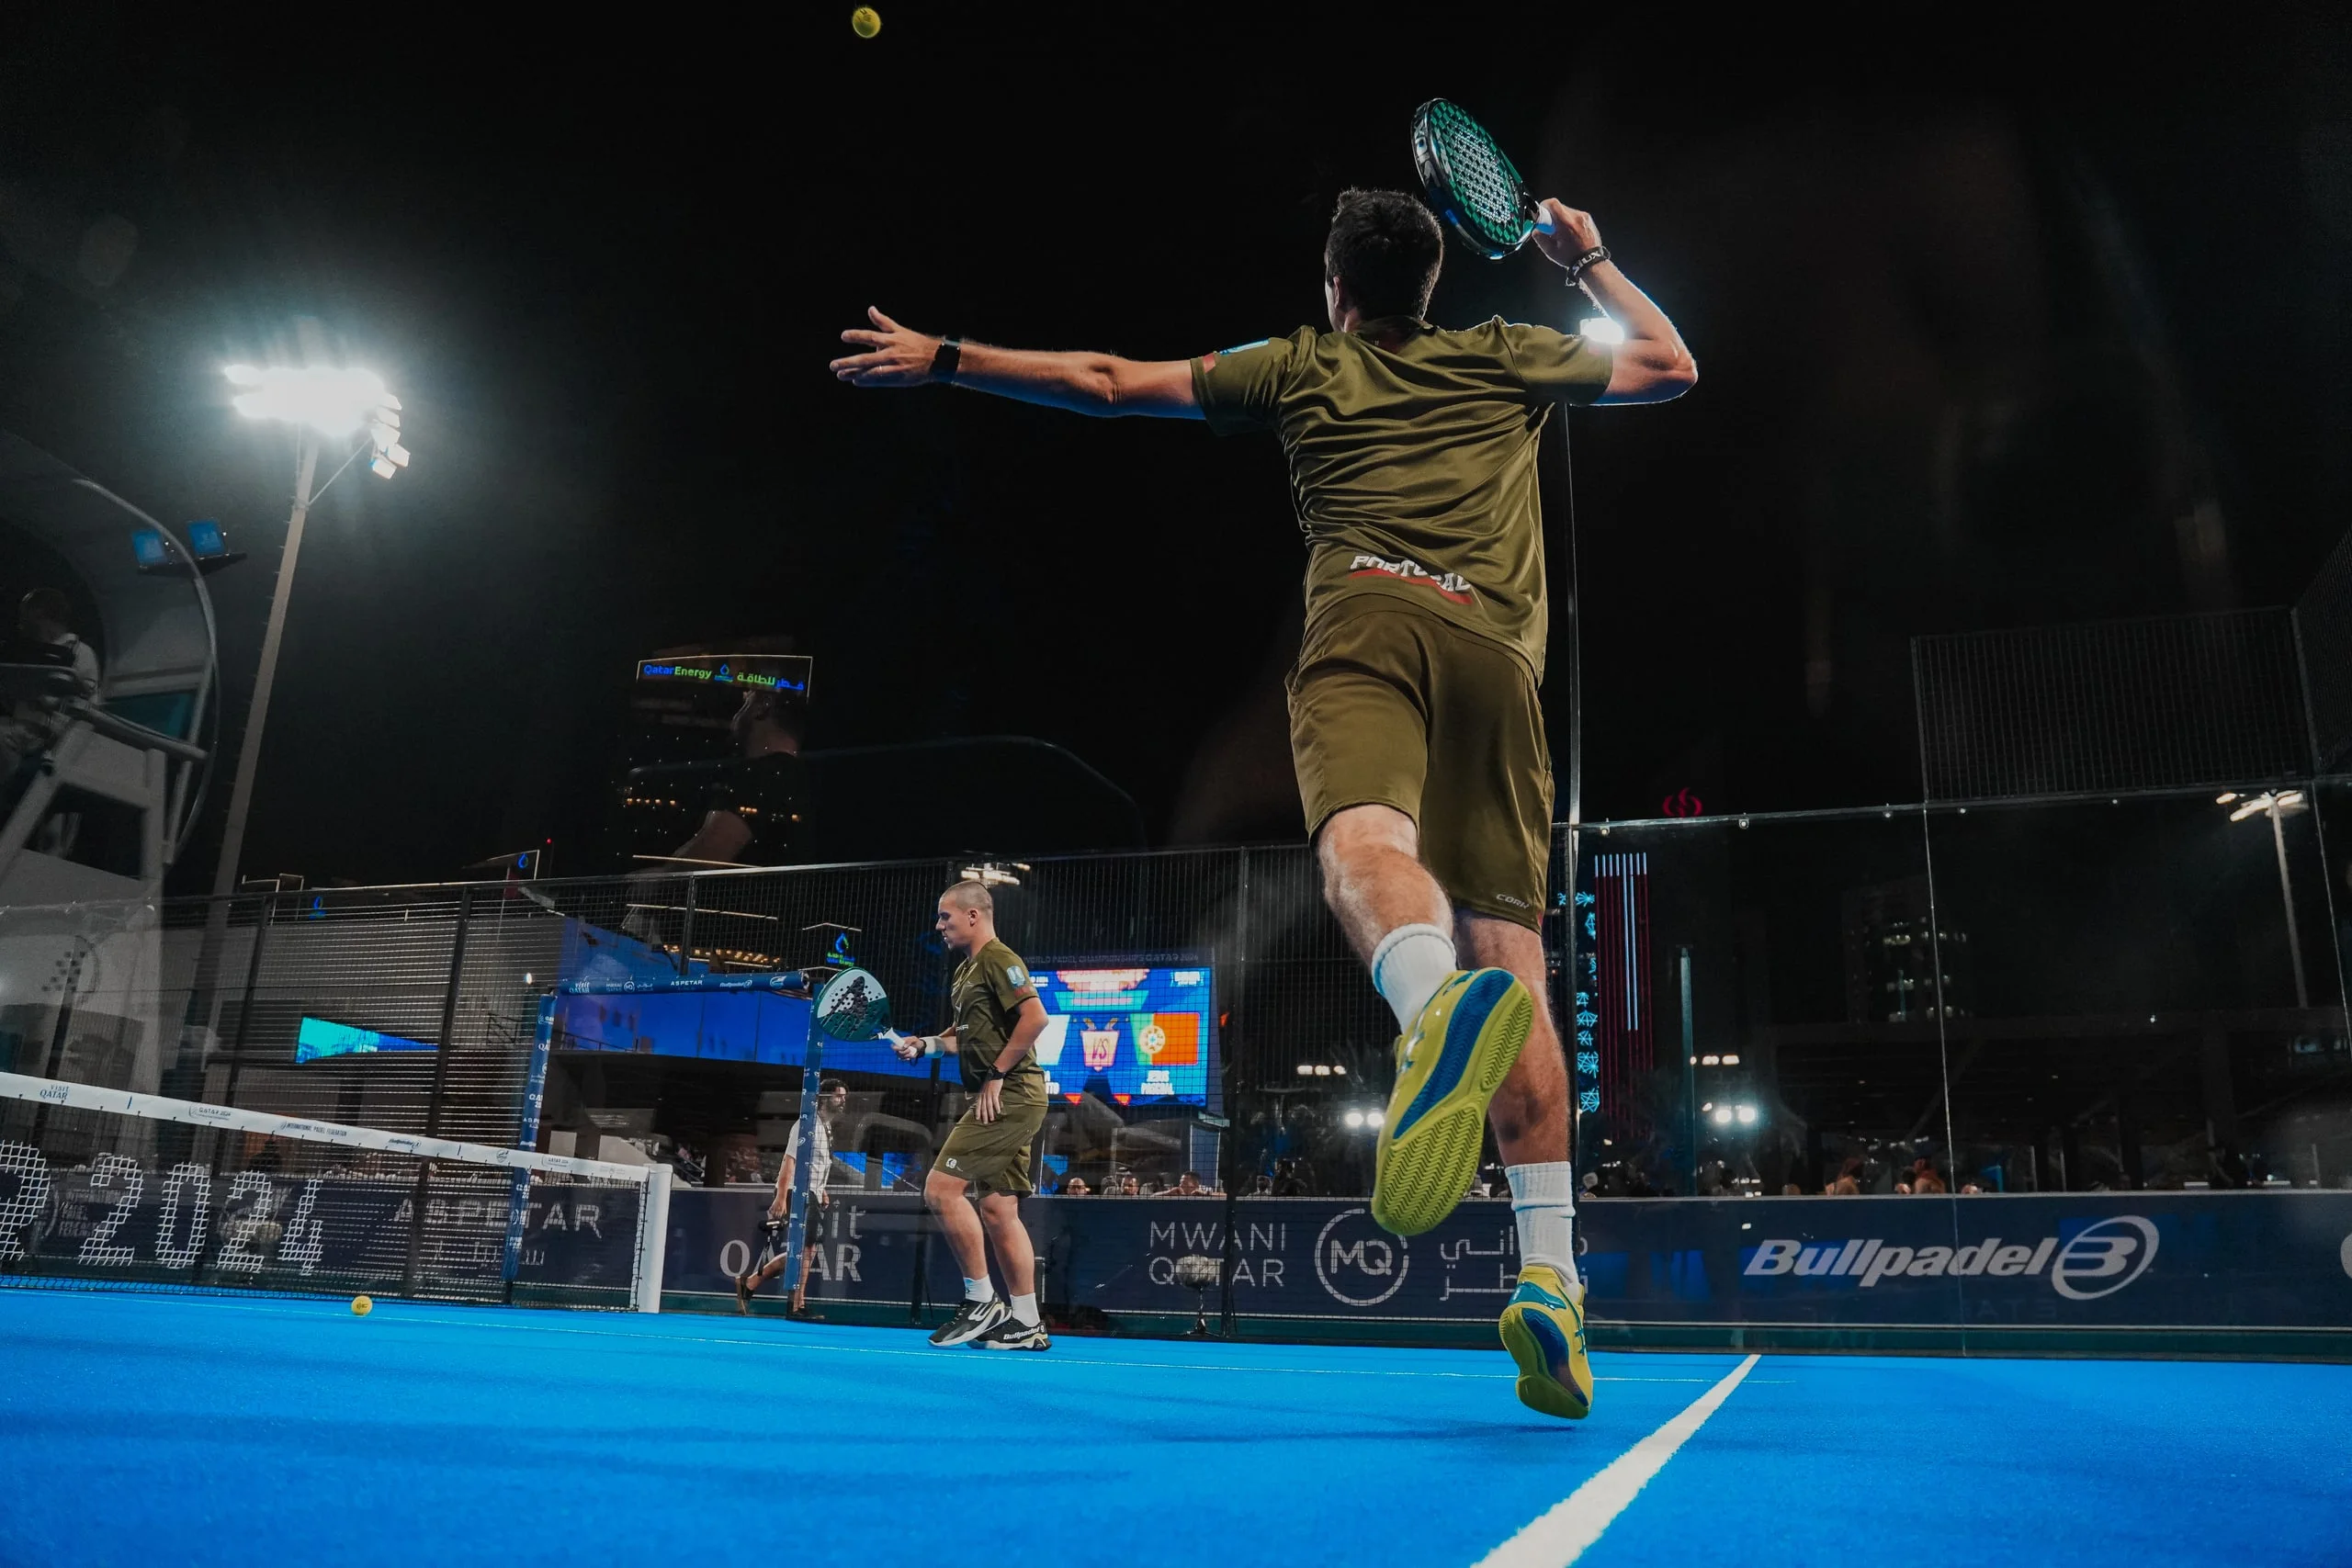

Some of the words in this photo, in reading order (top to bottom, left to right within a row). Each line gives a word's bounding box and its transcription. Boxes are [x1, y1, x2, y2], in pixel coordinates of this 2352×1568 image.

[644, 664, 712, 681] QatarEnergy
[40, 1089, 69, 1100] QATAR
[79, 1154, 322, 1276] 2024
[1148, 1256, 1285, 1286] QTAR
[1743, 1237, 2059, 1287] Bullpadel
